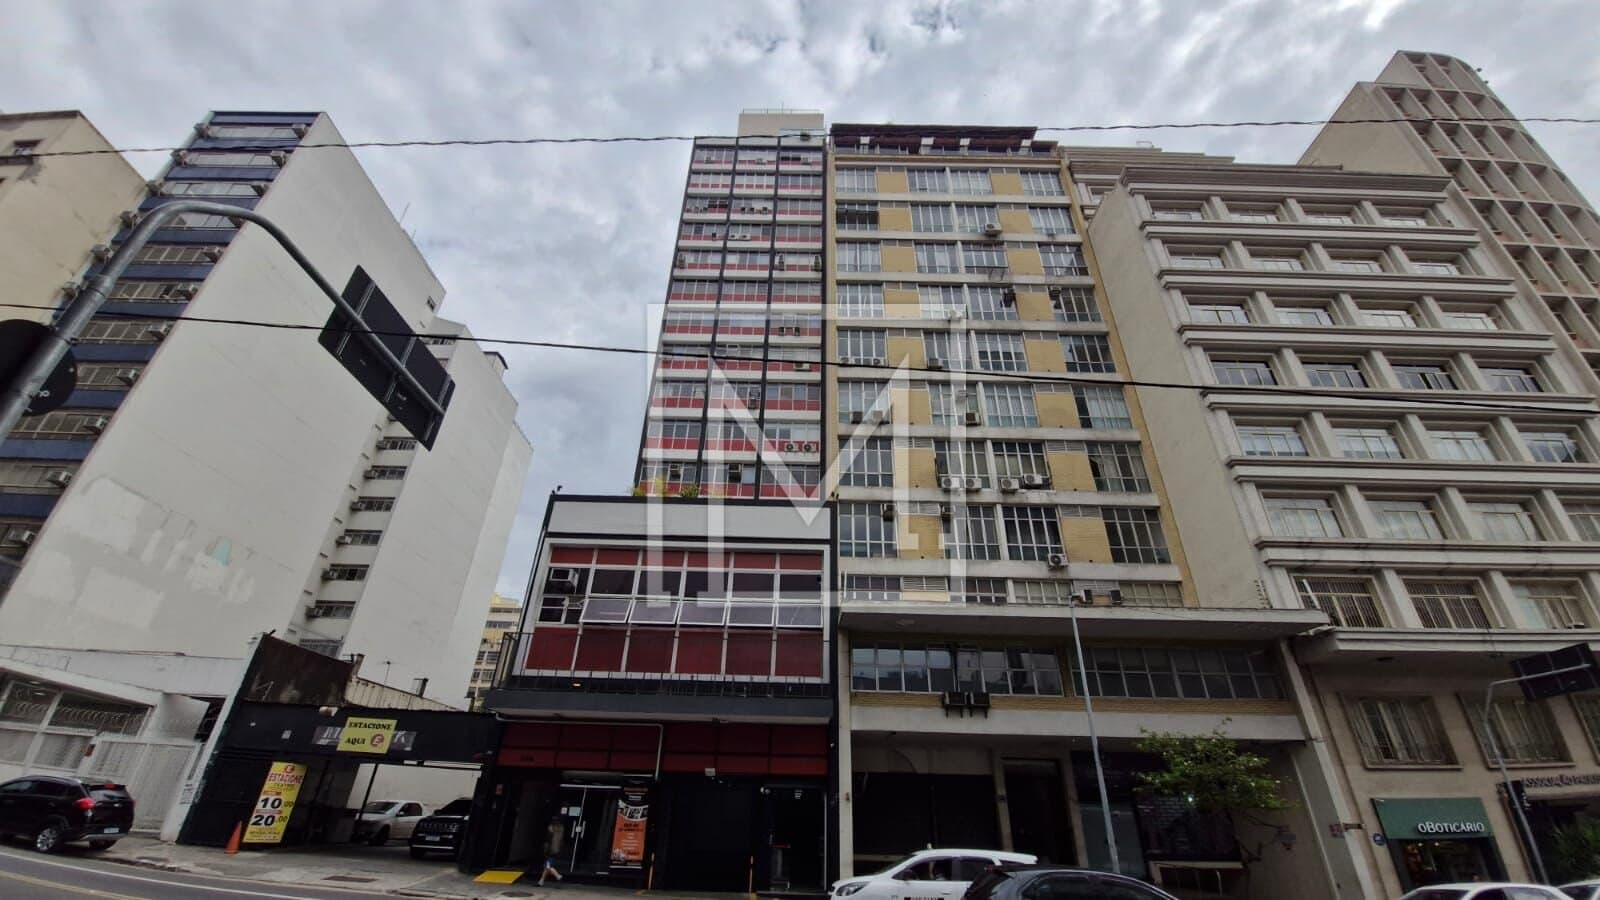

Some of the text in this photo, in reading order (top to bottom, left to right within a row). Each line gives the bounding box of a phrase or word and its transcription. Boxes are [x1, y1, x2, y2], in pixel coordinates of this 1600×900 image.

[348, 721, 393, 731] ESTACIONE
[344, 736, 367, 745] AQUI
[260, 797, 282, 809] 10
[251, 815, 276, 826] 20
